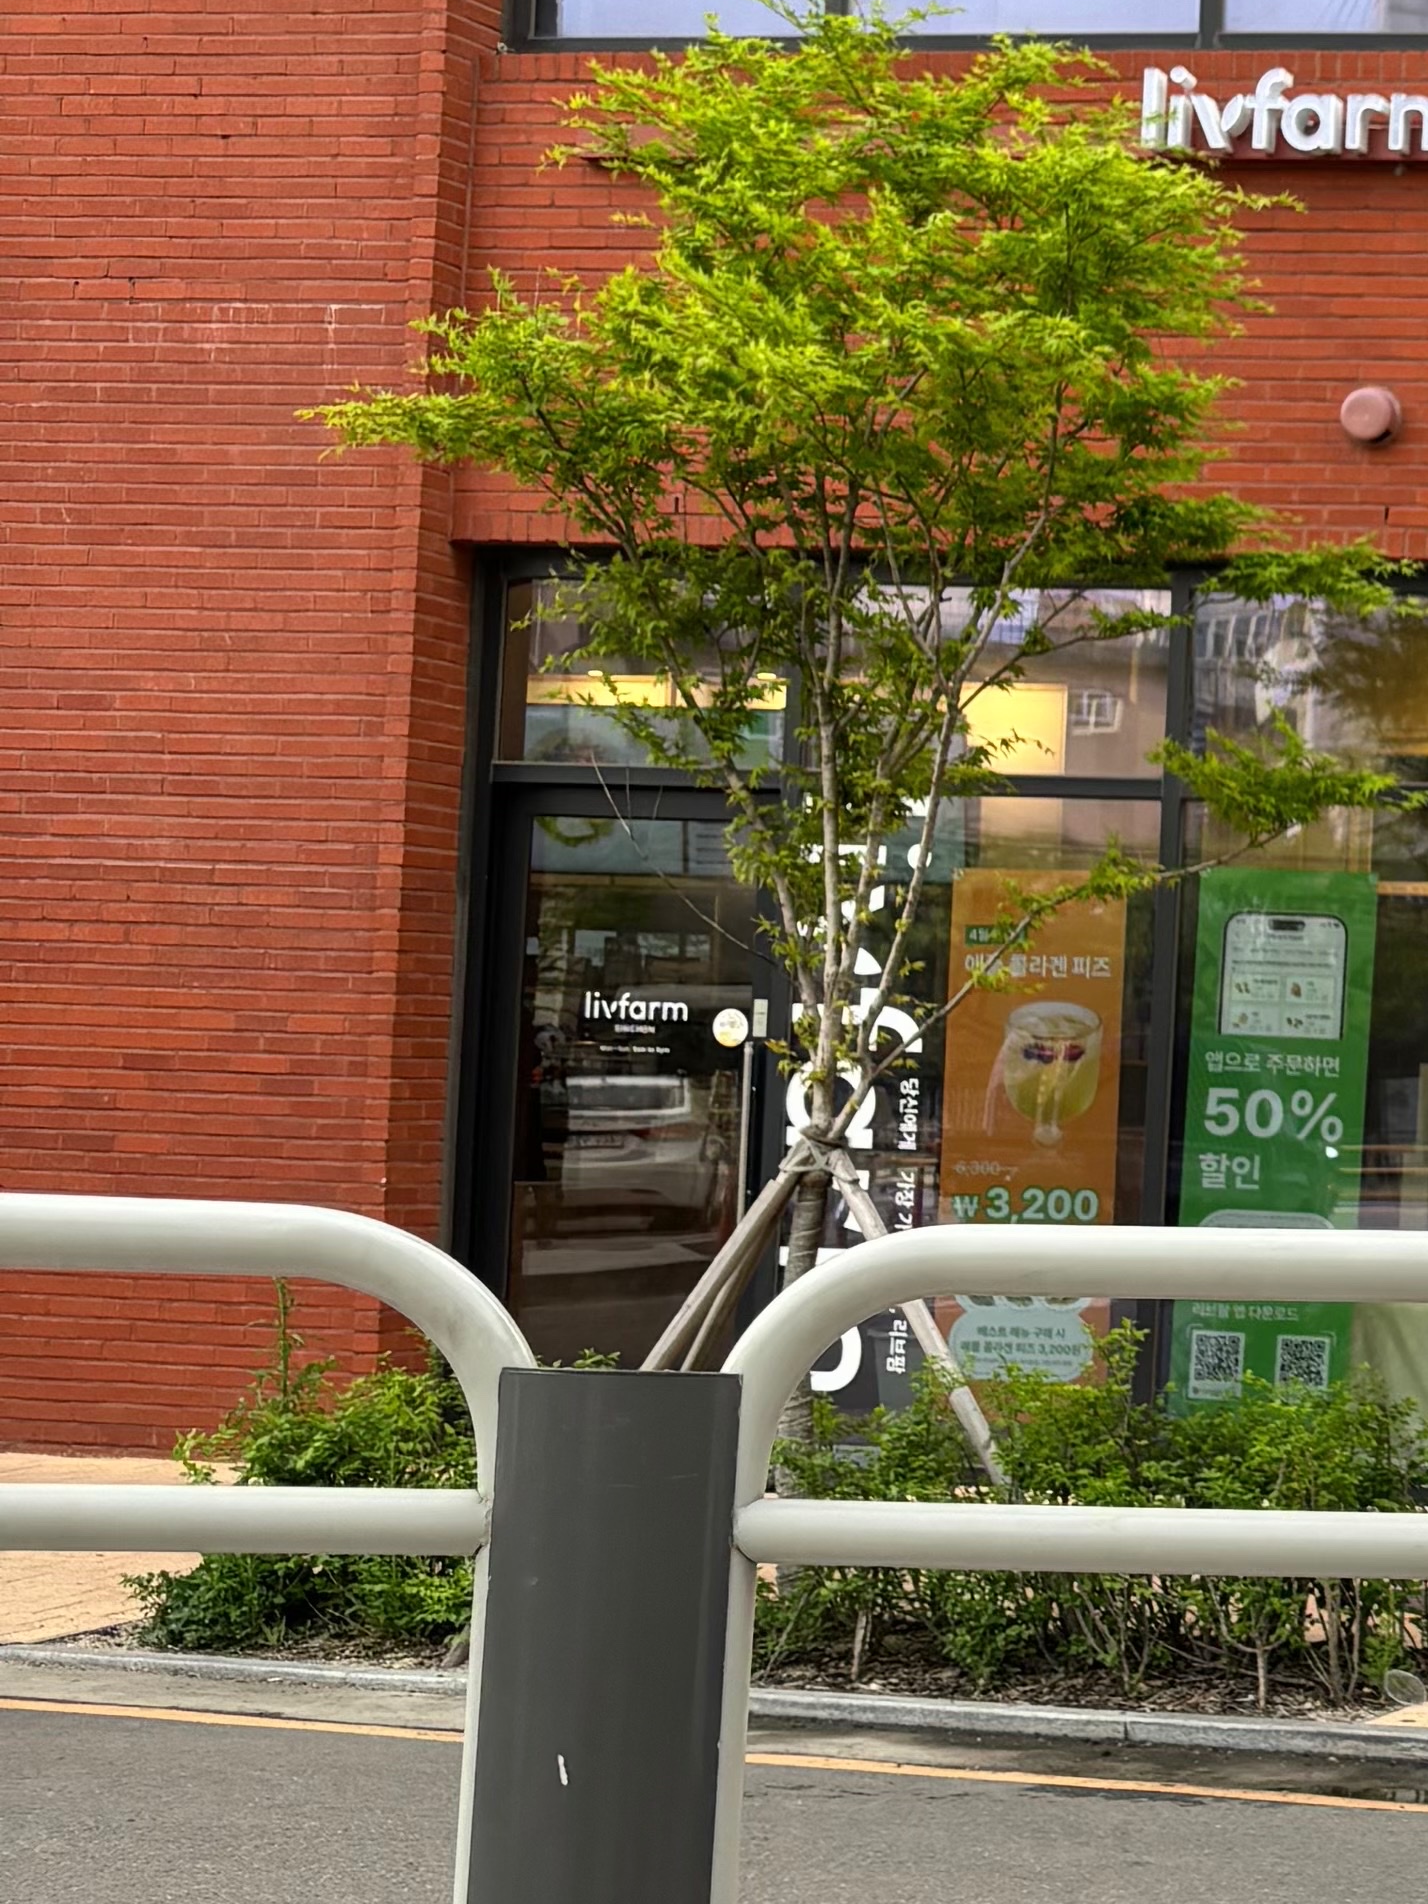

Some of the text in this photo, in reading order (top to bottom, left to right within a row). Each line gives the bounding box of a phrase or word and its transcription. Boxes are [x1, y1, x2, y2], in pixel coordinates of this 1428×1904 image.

[1071, 955, 1112, 979] 피즈
[583, 990, 689, 1022] livfarm
[1204, 1050, 1341, 1078] 앱으로 주문하면
[1203, 1086, 1344, 1143] 50%
[1198, 1151, 1261, 1190] 할인
